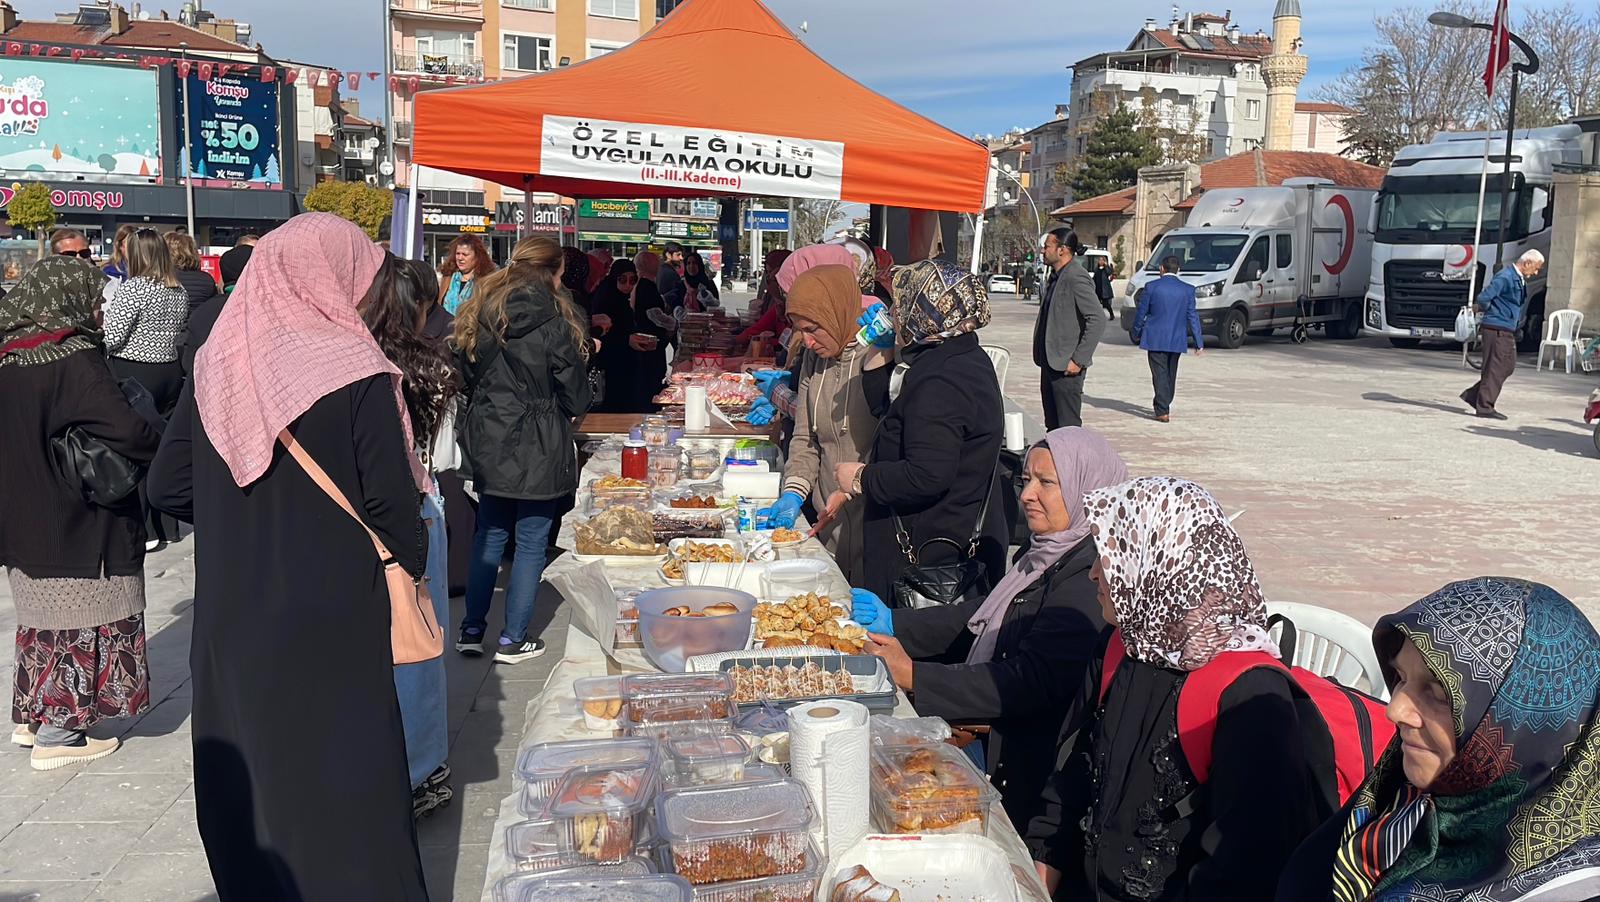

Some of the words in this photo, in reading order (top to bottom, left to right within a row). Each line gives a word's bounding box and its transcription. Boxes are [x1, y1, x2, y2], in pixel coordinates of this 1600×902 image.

[206, 81, 249, 101] Komşu
[200, 120, 220, 129] net
[572, 121, 665, 148] ÖZEL
[683, 133, 815, 161] EĞİTİM
[571, 145, 720, 172] UYGULAMA
[724, 158, 813, 179] OKULU
[641, 167, 742, 189] (II.-III.Kademe)
[50, 189, 123, 211] omşu
